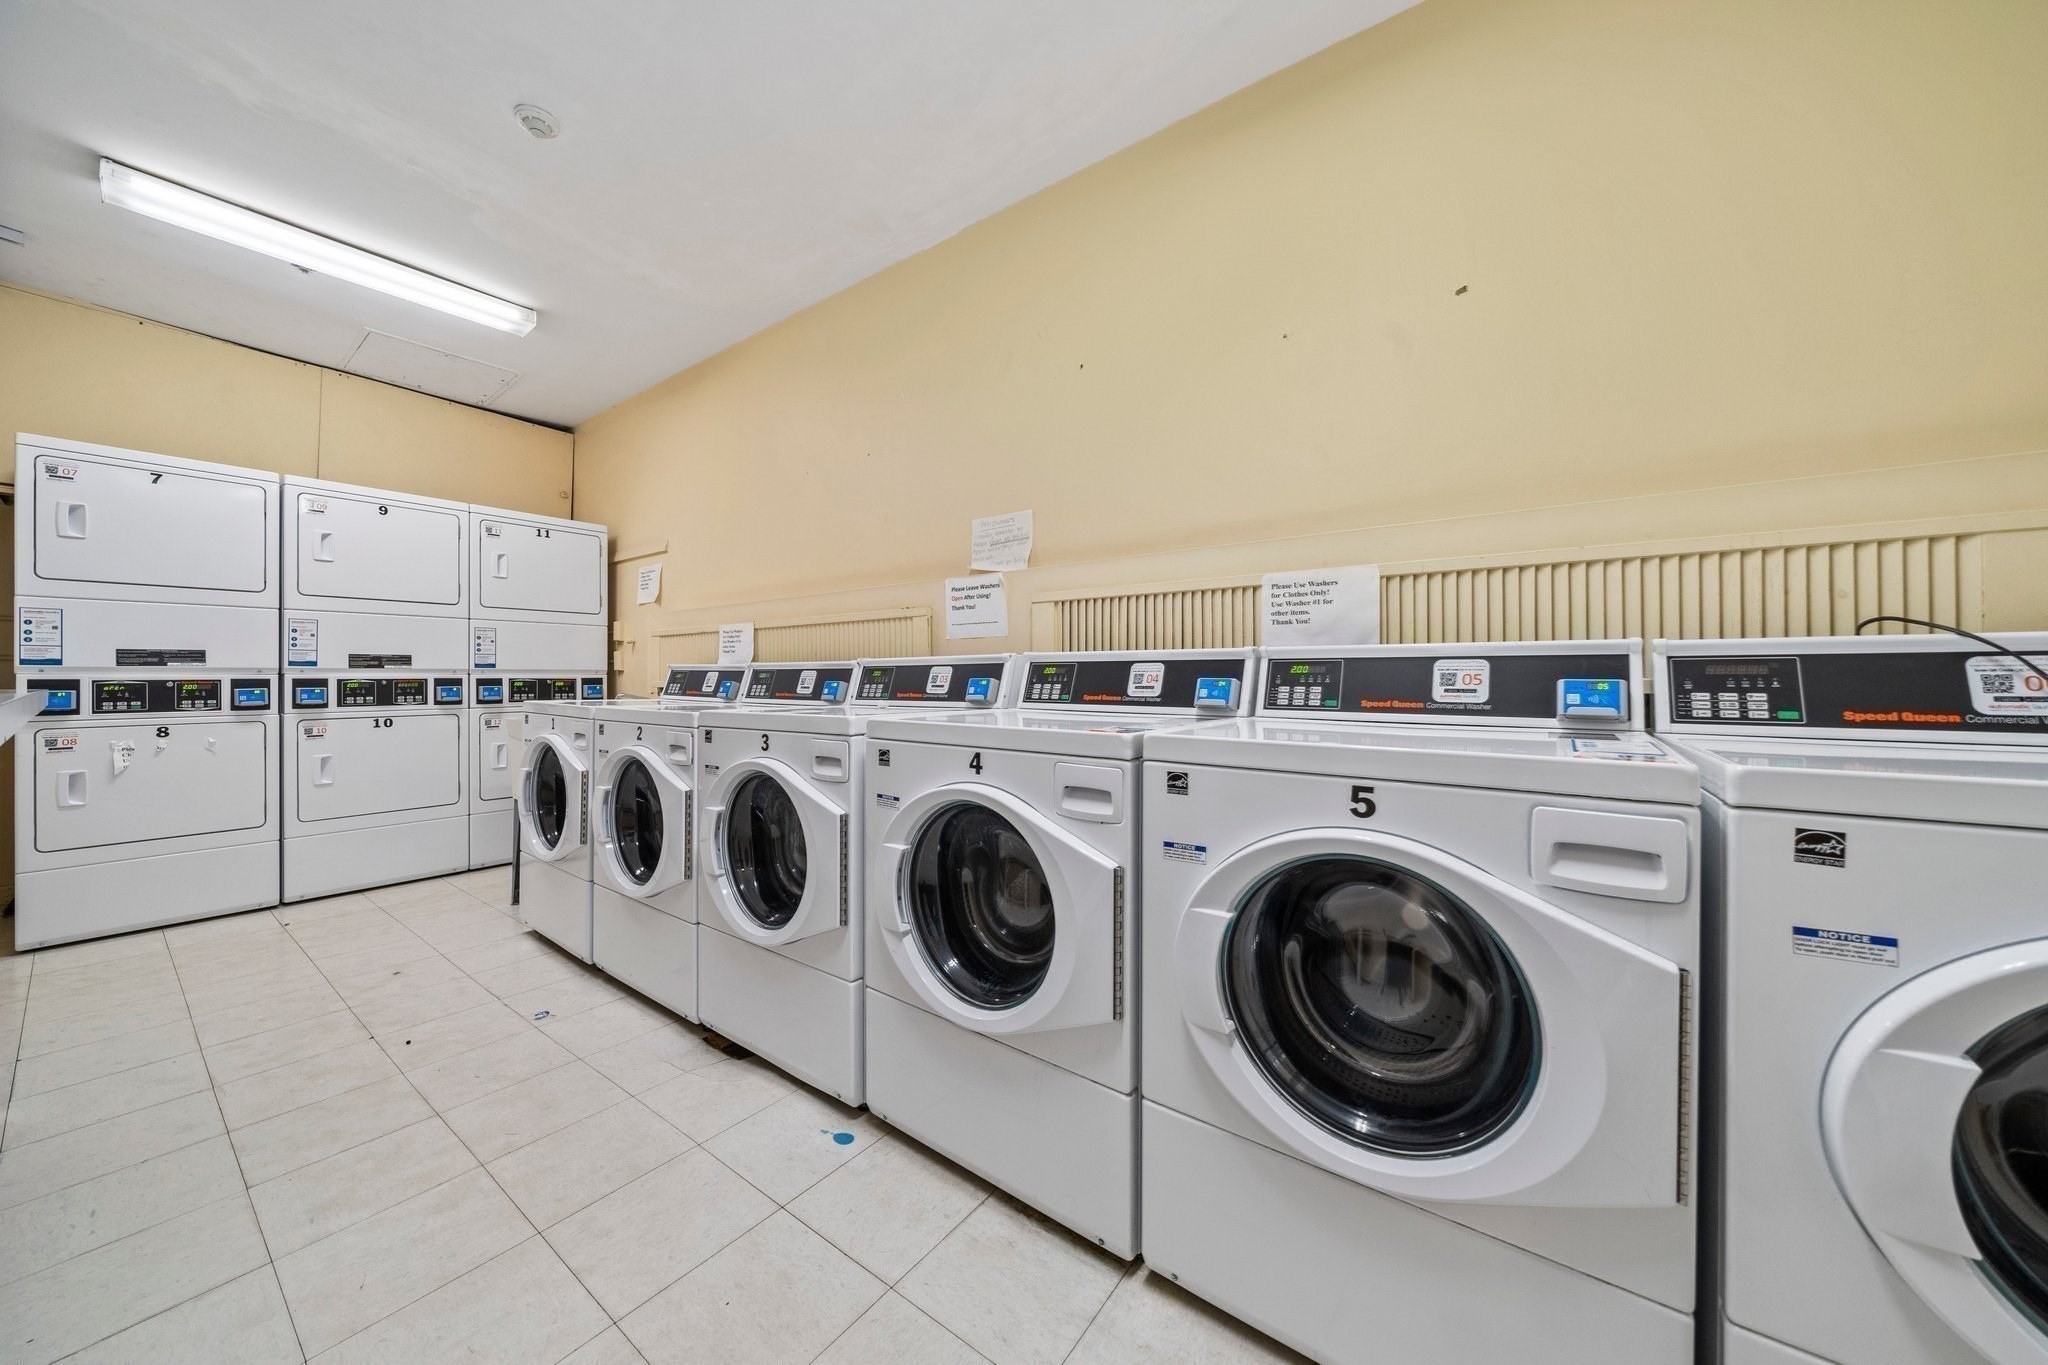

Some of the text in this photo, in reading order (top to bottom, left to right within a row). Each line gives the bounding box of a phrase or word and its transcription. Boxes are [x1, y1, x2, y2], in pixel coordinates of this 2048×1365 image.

[150, 473, 163, 484] 7
[379, 506, 388, 515] 9
[536, 529, 550, 538] 11
[940, 675, 948, 683] 03
[1146, 674, 1159, 683] 04
[1462, 674, 1482, 686] 05
[2024, 676, 2048, 692] 0
[1361, 700, 1391, 708] Speed
[1426, 702, 1464, 710] Commercial
[373, 718, 393, 728] 10
[1843, 711, 1898, 722] Speed
[1902, 712, 1961, 723] Queen
[1966, 715, 2039, 724] Commercial
[552, 718, 556, 730] 1
[156, 726, 170, 738] 8
[637, 727, 642, 741] 2
[761, 734, 769, 751] 3
[969, 752, 983, 775] 4
[1350, 785, 1376, 818] 5
[1794, 856, 1844, 867] ENERGY STAR
[1818, 931, 1871, 943] NOTICE
